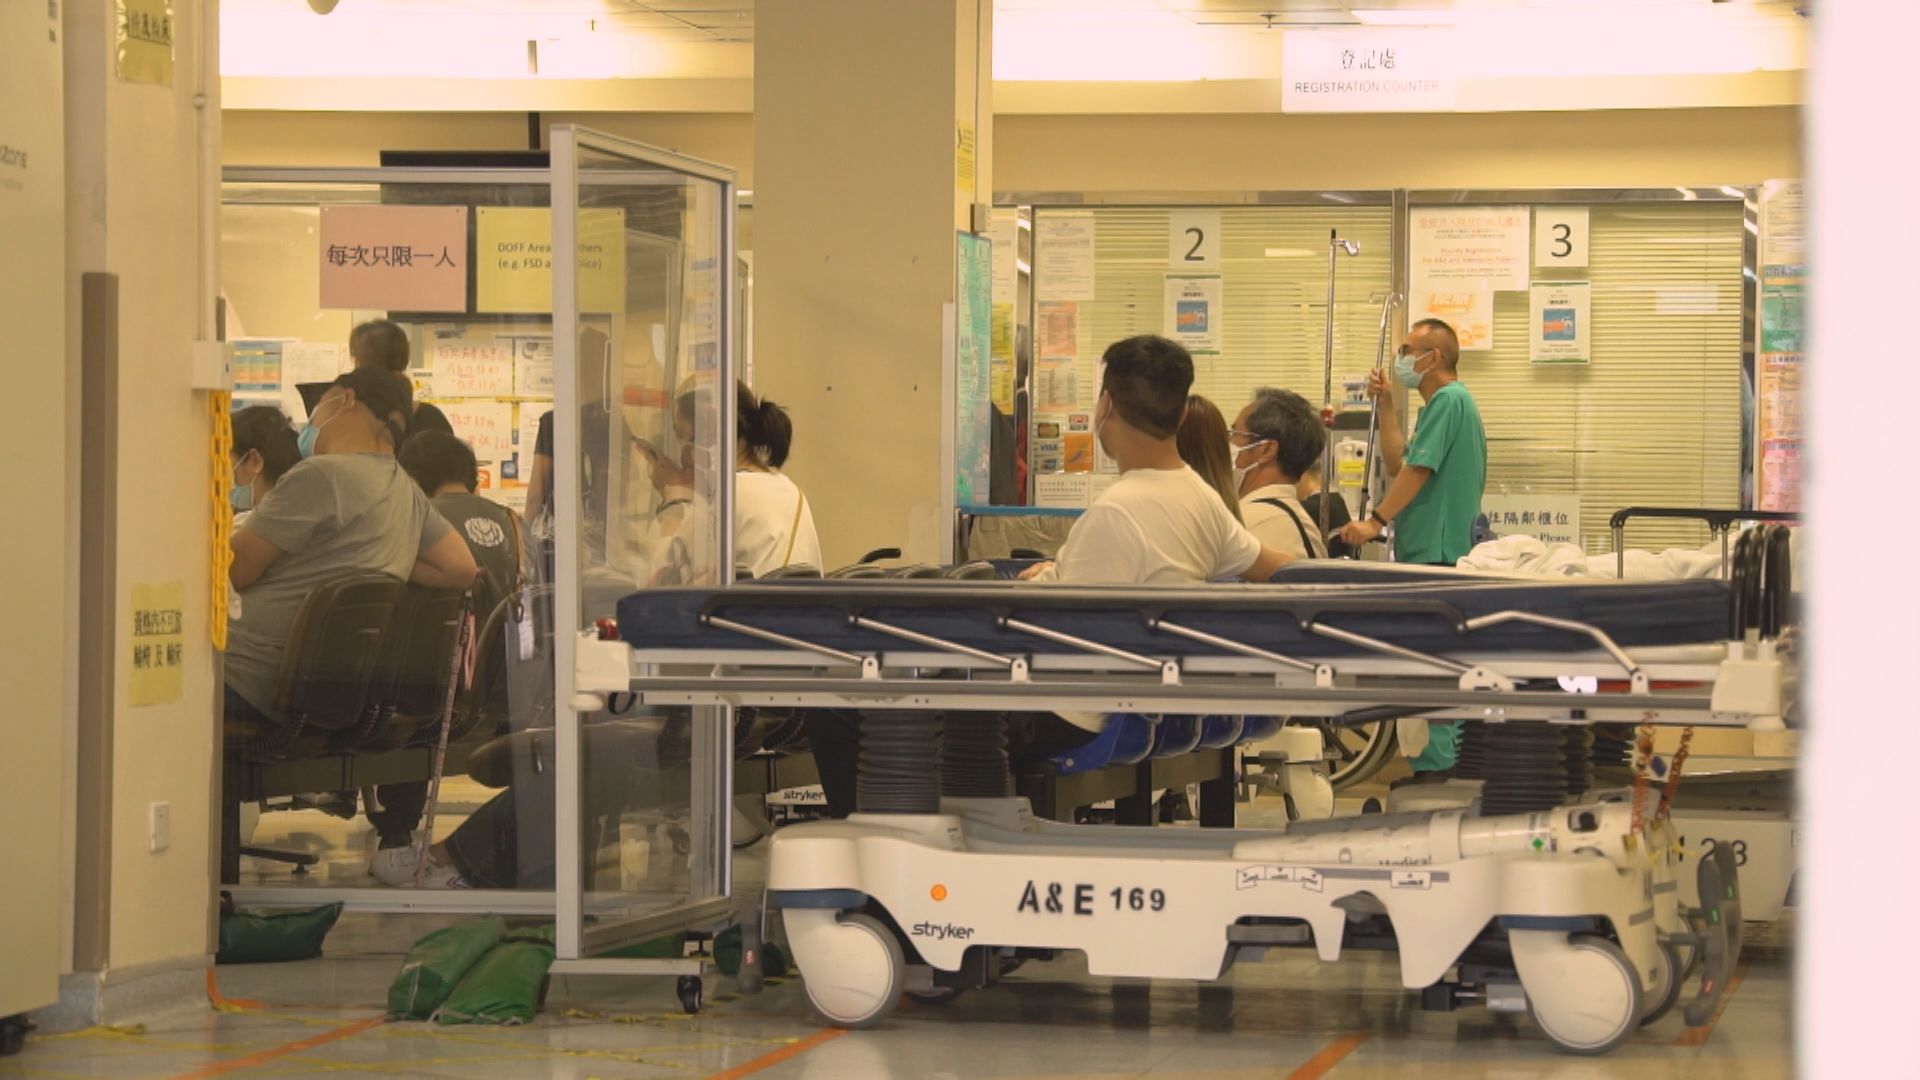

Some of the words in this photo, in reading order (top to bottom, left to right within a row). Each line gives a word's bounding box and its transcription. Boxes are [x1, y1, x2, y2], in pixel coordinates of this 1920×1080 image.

[1294, 80, 1379, 93] REGISTRATION
[1383, 79, 1441, 92] COUNTER
[497, 242, 524, 253] DOFF
[528, 242, 551, 253] Area
[1184, 227, 1205, 262] 2
[1550, 223, 1573, 258] 3
[327, 244, 457, 268] 每次只限一人
[523, 258, 543, 269] FSD
[783, 789, 824, 801] stryker
[1017, 880, 1095, 916] A&E
[1109, 886, 1166, 912] 169
[911, 920, 975, 940] stryker
